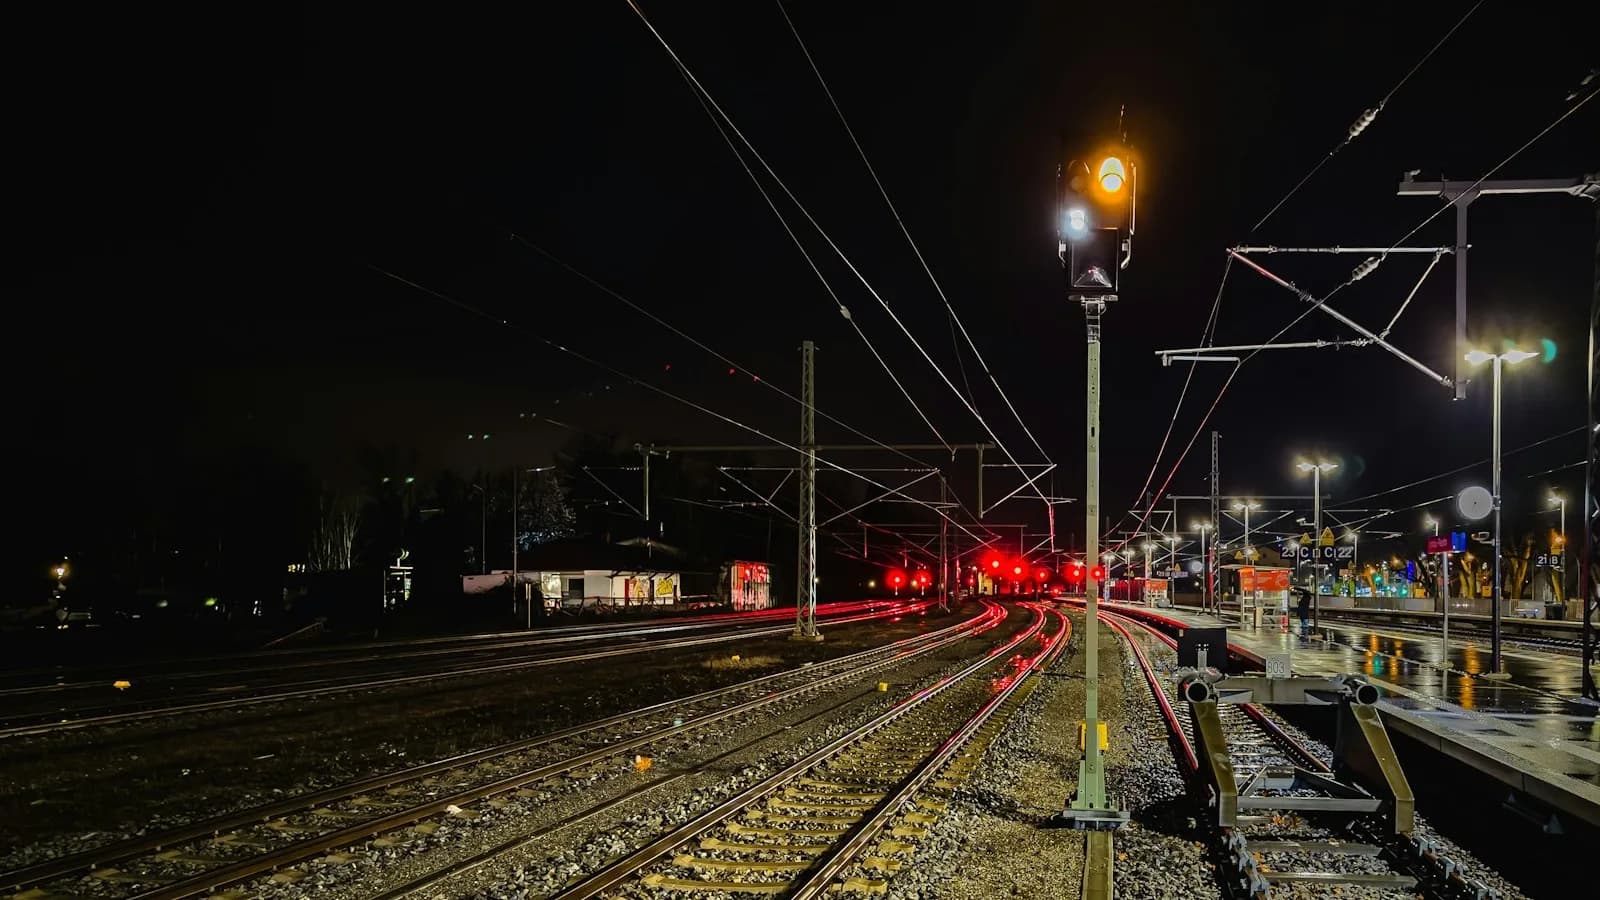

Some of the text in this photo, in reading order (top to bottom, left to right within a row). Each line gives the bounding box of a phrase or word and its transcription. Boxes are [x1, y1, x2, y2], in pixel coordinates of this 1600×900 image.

[1281, 547, 1309, 557] 23 C
[1324, 547, 1352, 558] C 22
